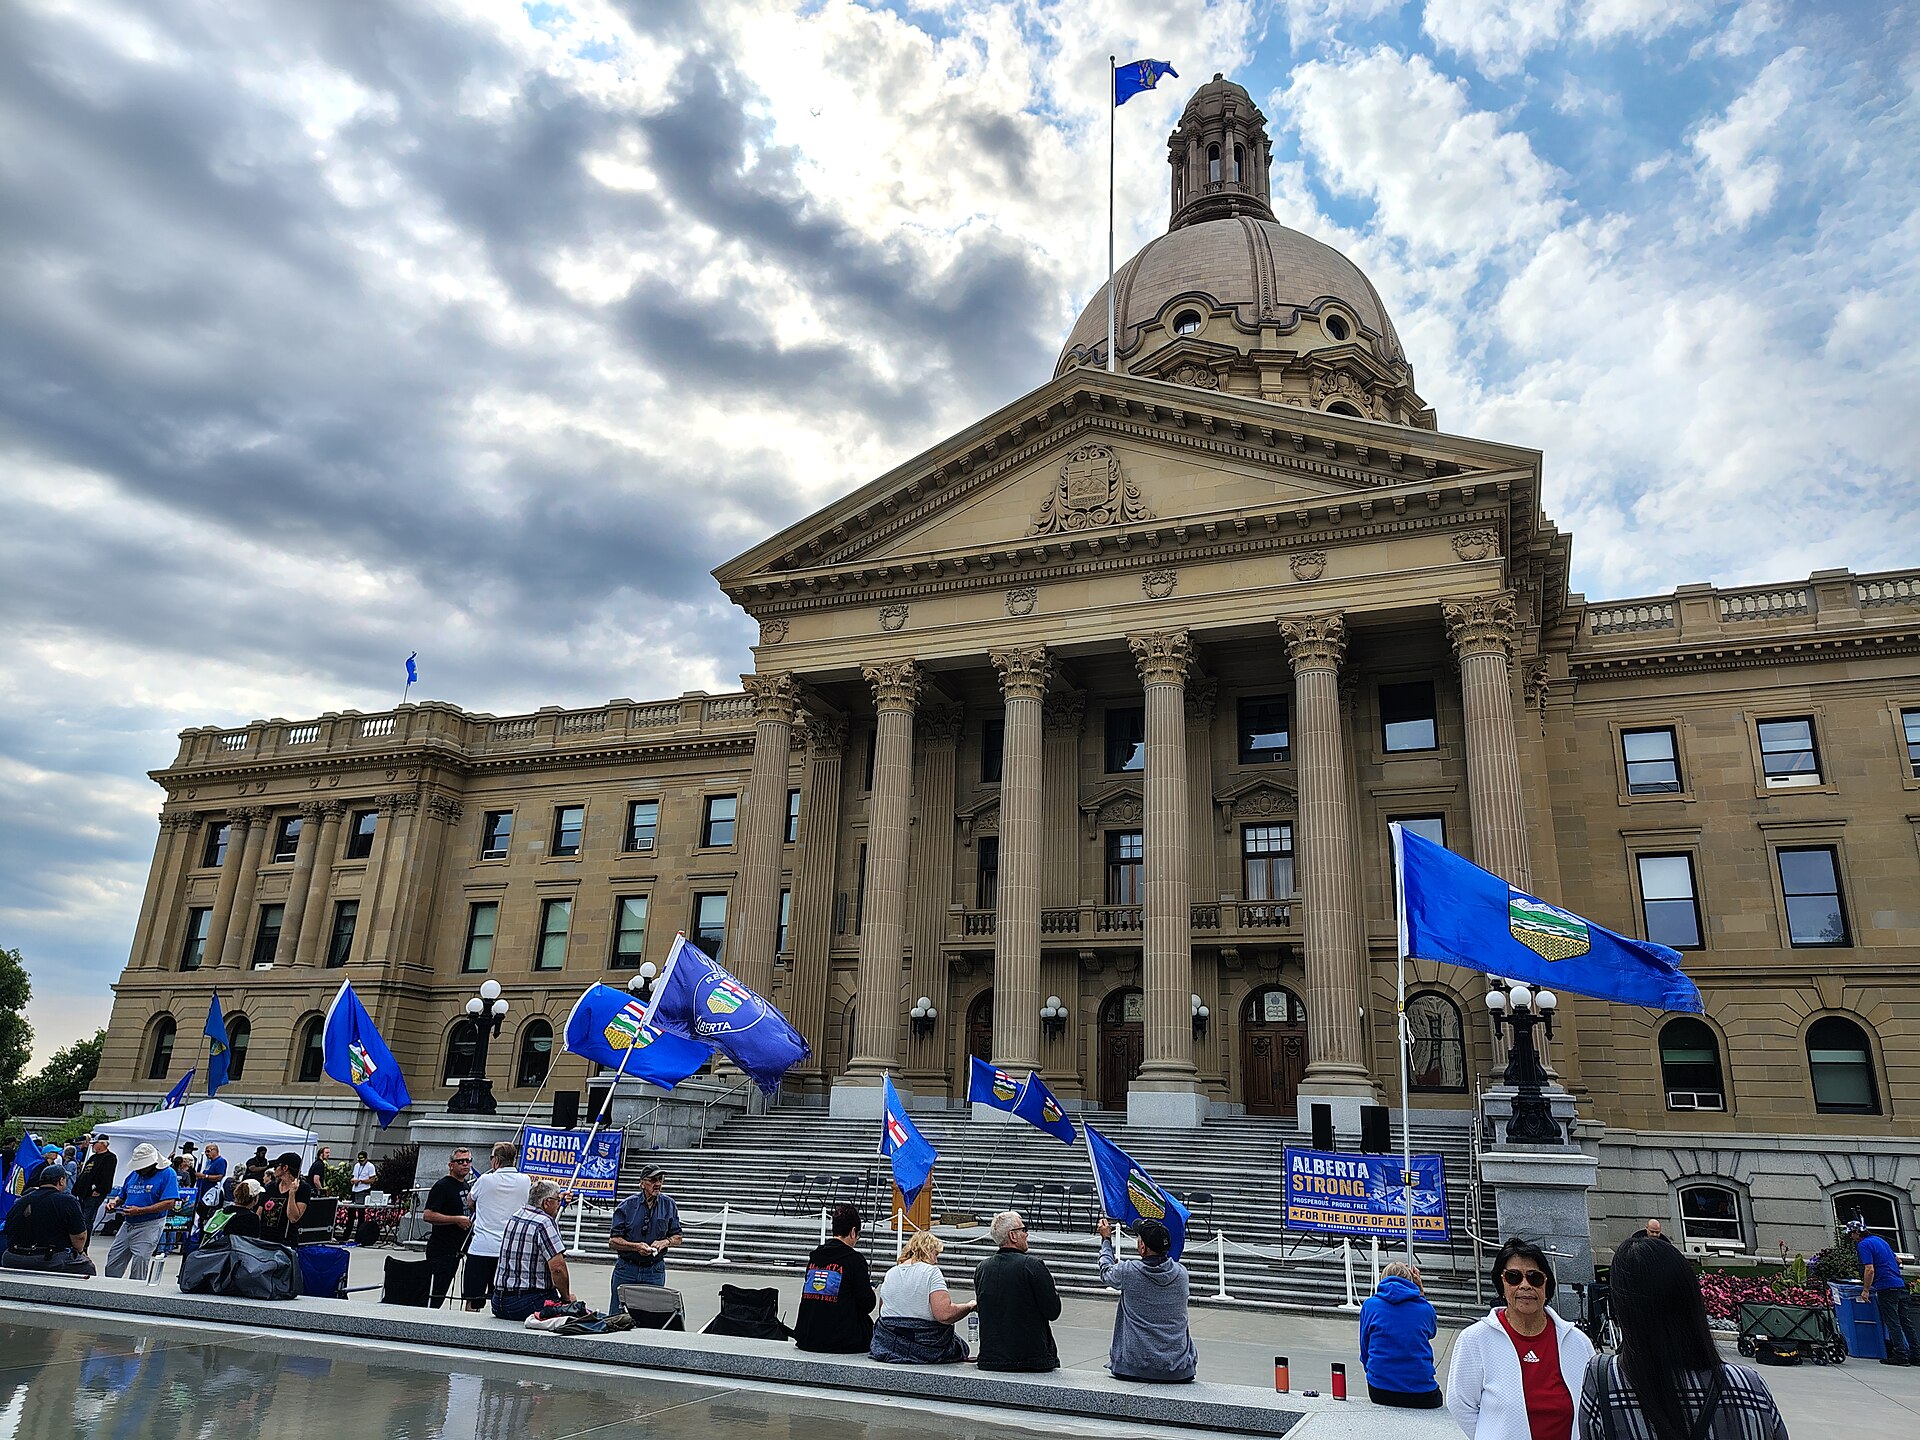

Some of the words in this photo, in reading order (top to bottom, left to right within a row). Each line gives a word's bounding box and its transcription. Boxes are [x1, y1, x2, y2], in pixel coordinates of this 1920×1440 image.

[528, 1133, 580, 1150] ALBERTA
[526, 1147, 579, 1165] STRONG.
[1292, 1156, 1370, 1179] ALBERTA
[581, 1180, 609, 1189] ALBERTA
[1292, 1174, 1371, 1197] STRONG.
[1293, 1197, 1331, 1206] PROSPEROUS.
[1331, 1201, 1353, 1209] PROUD.
[1300, 1209, 1318, 1220] FOR
[1322, 1211, 1340, 1222] THE
[1344, 1213, 1368, 1225] LOVE
[1371, 1216, 1383, 1226] OF
[1386, 1217, 1432, 1228] ALBRTA
